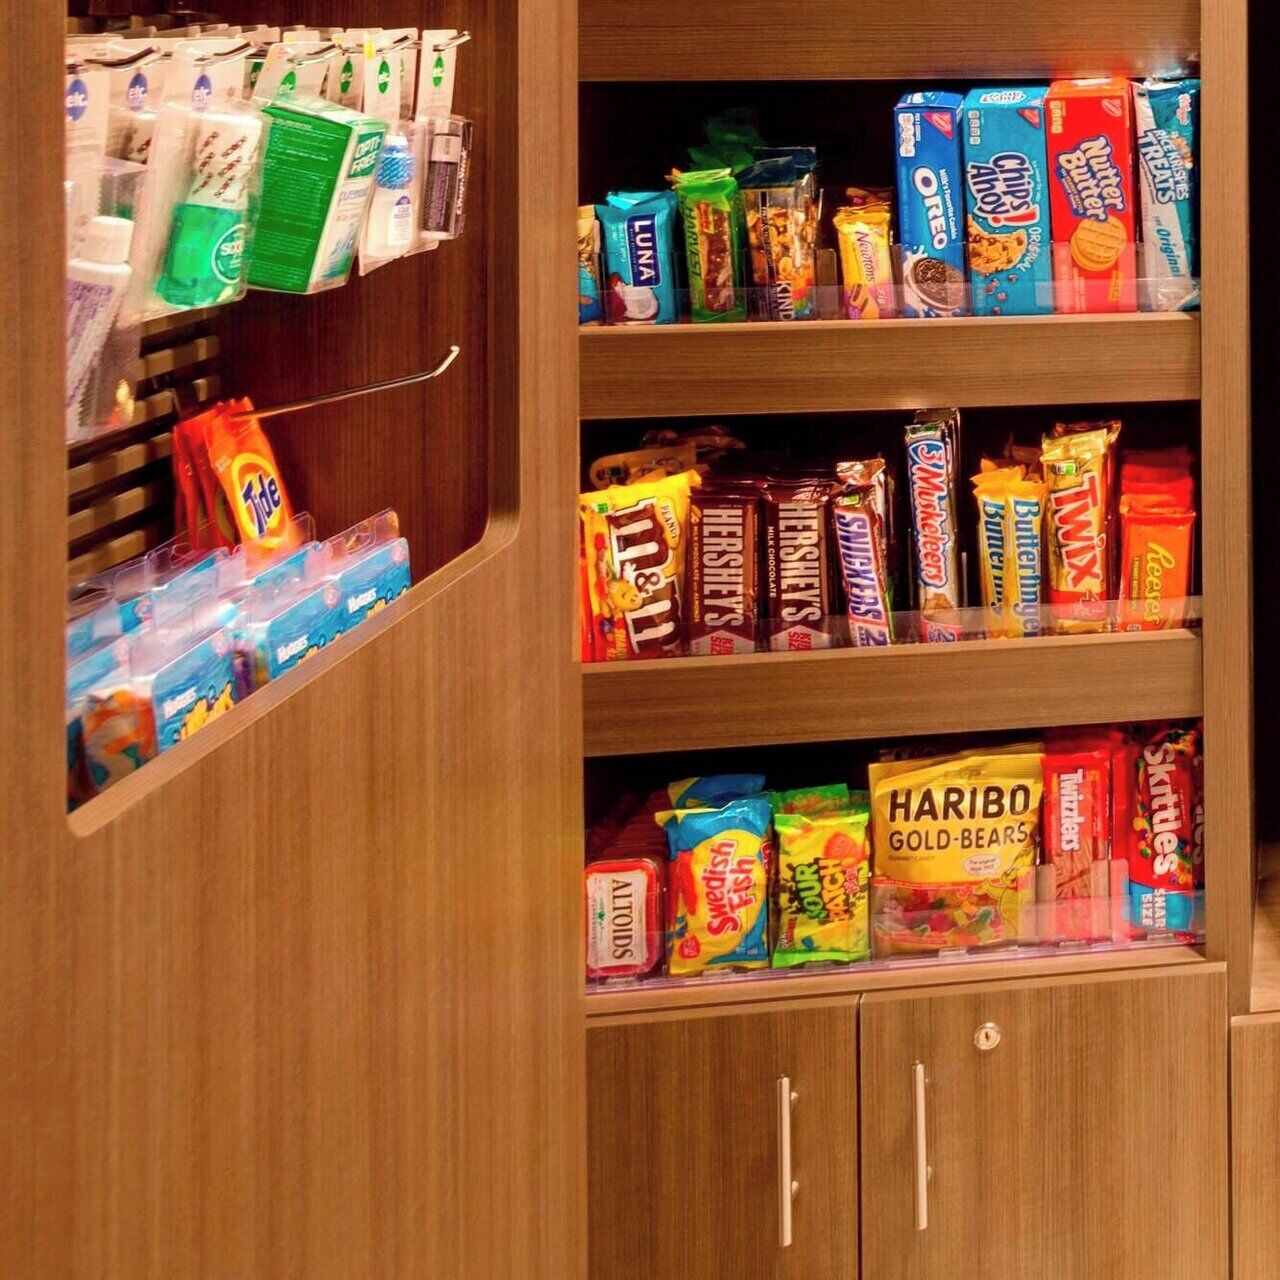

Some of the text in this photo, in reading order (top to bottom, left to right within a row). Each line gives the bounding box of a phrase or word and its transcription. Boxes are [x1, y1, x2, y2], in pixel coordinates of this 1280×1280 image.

[992, 152, 1032, 214] Chips
[1057, 149, 1107, 221] Butter
[1079, 136, 1125, 211] Nutter
[1138, 129, 1177, 205] TREATS
[912, 166, 949, 250] OREO
[633, 219, 655, 281] LUNA
[855, 230, 877, 282] Newtons
[1156, 227, 1181, 278] Original
[776, 280, 795, 321] KIND
[242, 471, 281, 538] Tide
[660, 504, 678, 540] PEANUT
[912, 462, 949, 588] Musketeers
[1050, 472, 1102, 591] TWIX
[702, 508, 744, 628] HERSHEY'S
[766, 525, 777, 599] MILK CHOCOLATE
[777, 502, 822, 622] HERSHEY'S
[835, 512, 884, 622] SNICKERS
[888, 783, 1032, 823] HARIBO
[888, 822, 1030, 853] GOLD-BEARS
[1059, 768, 1084, 853] Twizzlers
[1143, 742, 1183, 877] Skittles
[611, 879, 634, 960] ALTOIDS
[701, 839, 739, 936] Swedish
[728, 855, 757, 916] Fish
[795, 863, 828, 920] SOUR
[1141, 893, 1154, 927] SIZE
